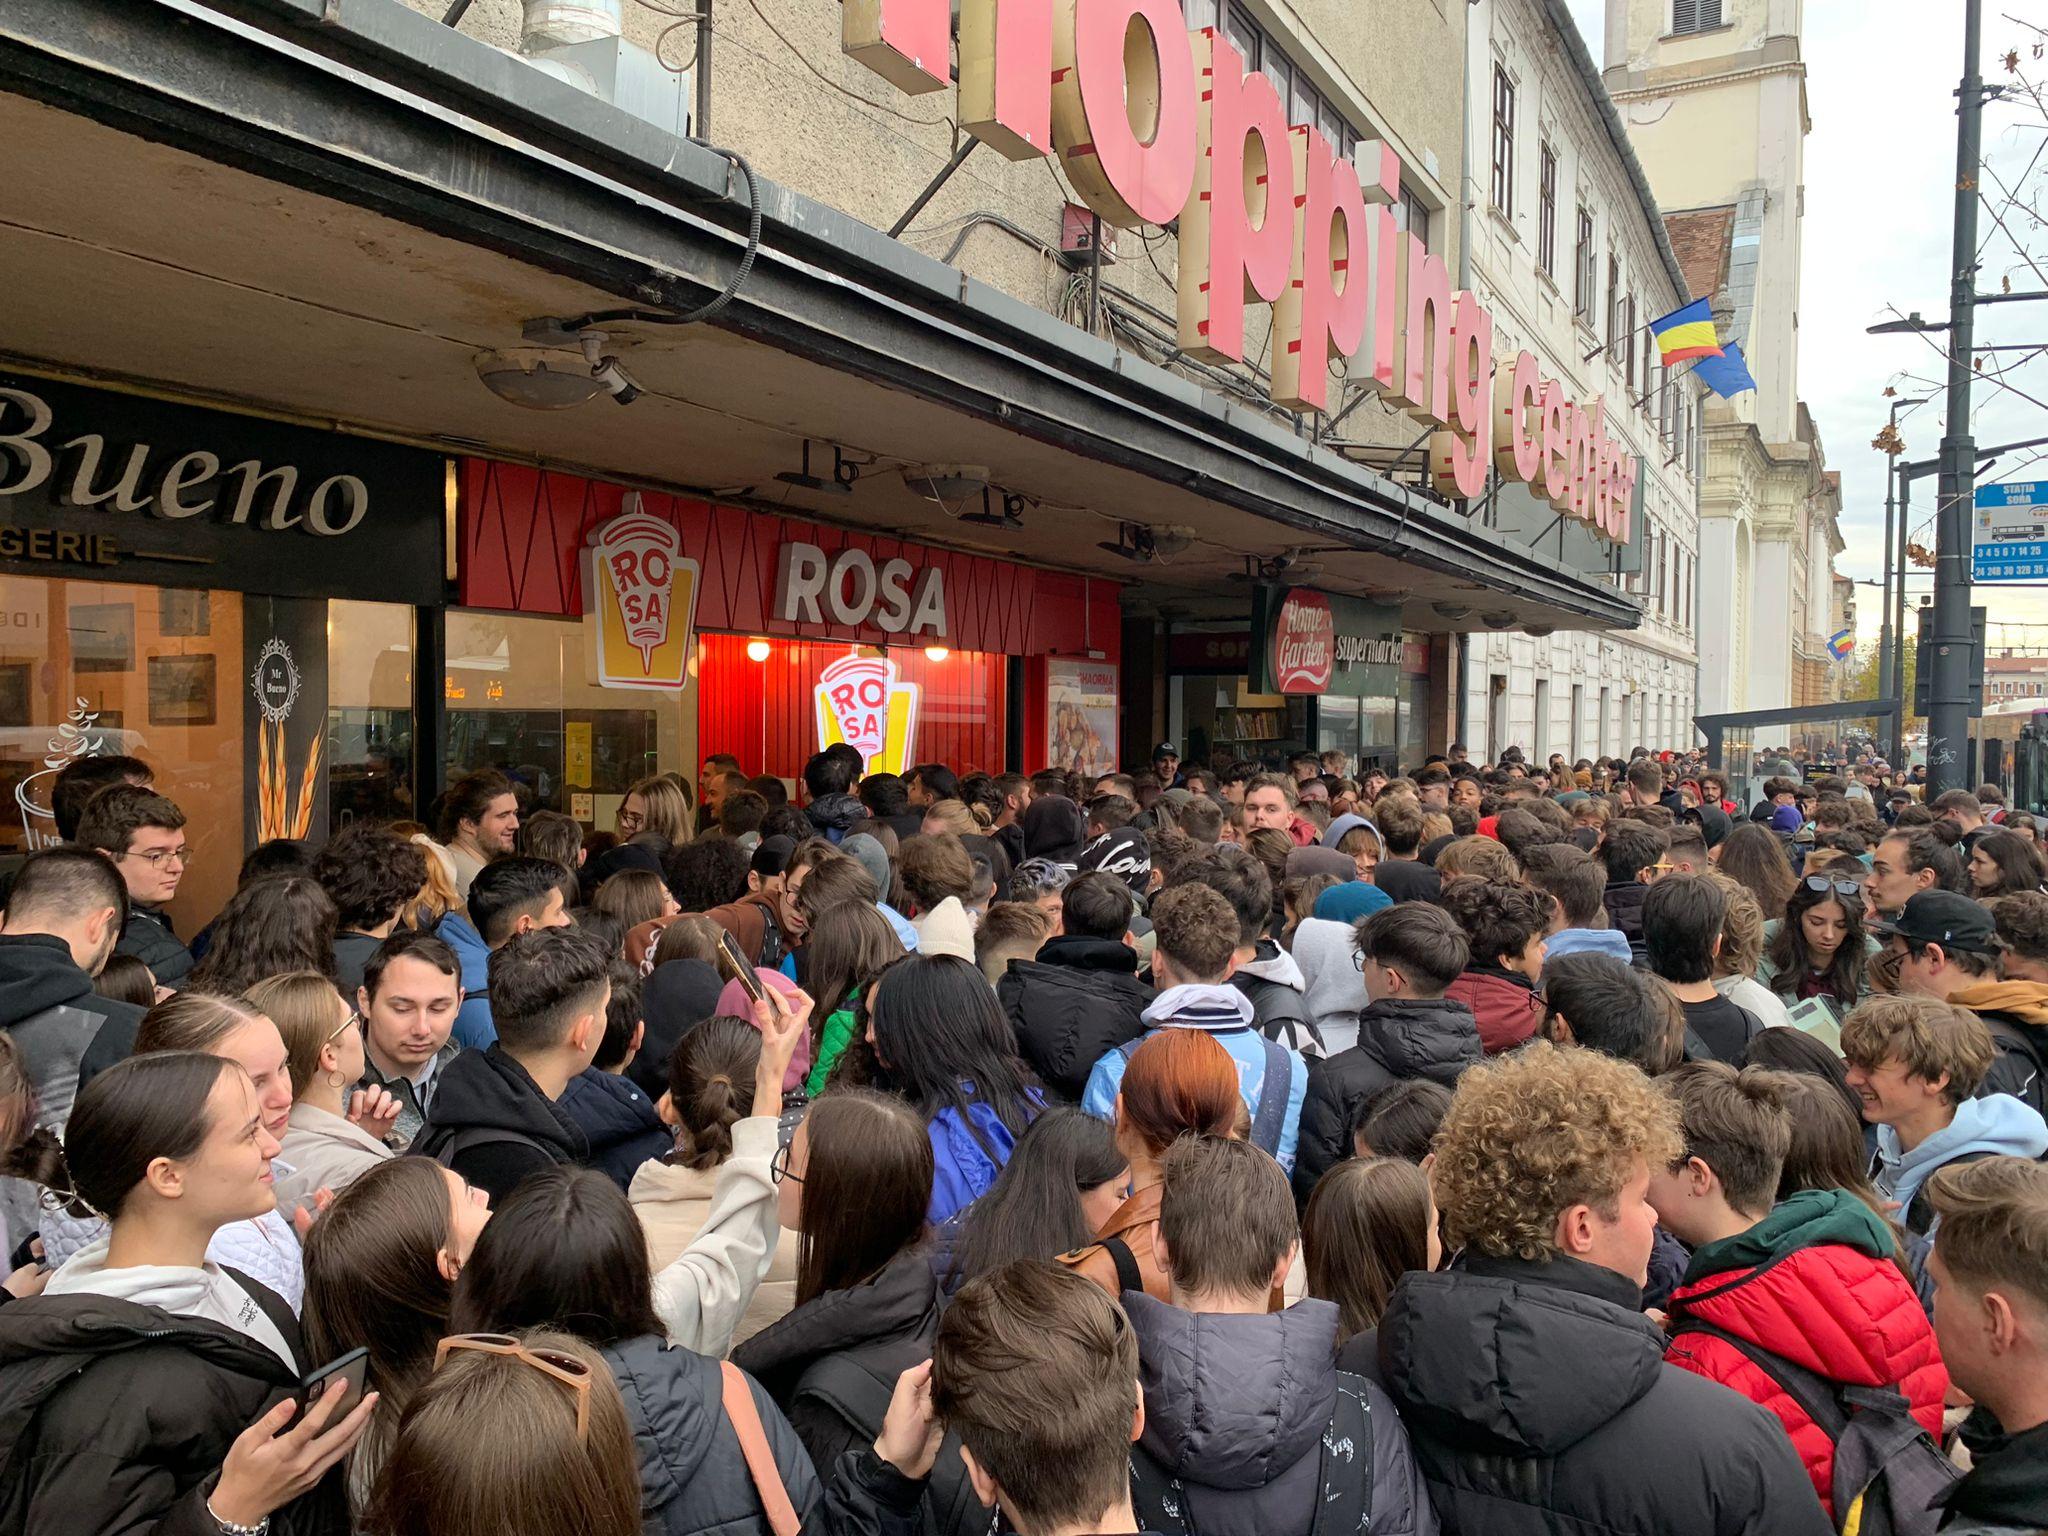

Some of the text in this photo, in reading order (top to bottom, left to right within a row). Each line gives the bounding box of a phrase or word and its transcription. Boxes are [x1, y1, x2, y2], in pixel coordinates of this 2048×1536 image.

[1495, 350, 1637, 545] center
[2006, 494, 2032, 505] SORA
[1978, 548, 1984, 558] 3
[1985, 548, 1992, 557] 4
[1994, 547, 2000, 557] 5
[2011, 546, 2017, 556] 7
[2019, 546, 2028, 556] 14
[2030, 545, 2041, 556] 25
[611, 549, 671, 592] RO
[1975, 566, 1985, 577] 24
[2033, 564, 2044, 575] 35
[783, 541, 947, 637] ROSA
[625, 593, 662, 625] SA
[1287, 600, 1324, 633] Home
[1279, 632, 1326, 677] Garden
[1336, 633, 1404, 672] supermarket
[266, 683, 287, 693] Bueno
[271, 669, 282, 679] Mr
[831, 679, 885, 715] RO
[844, 713, 879, 739] SA
